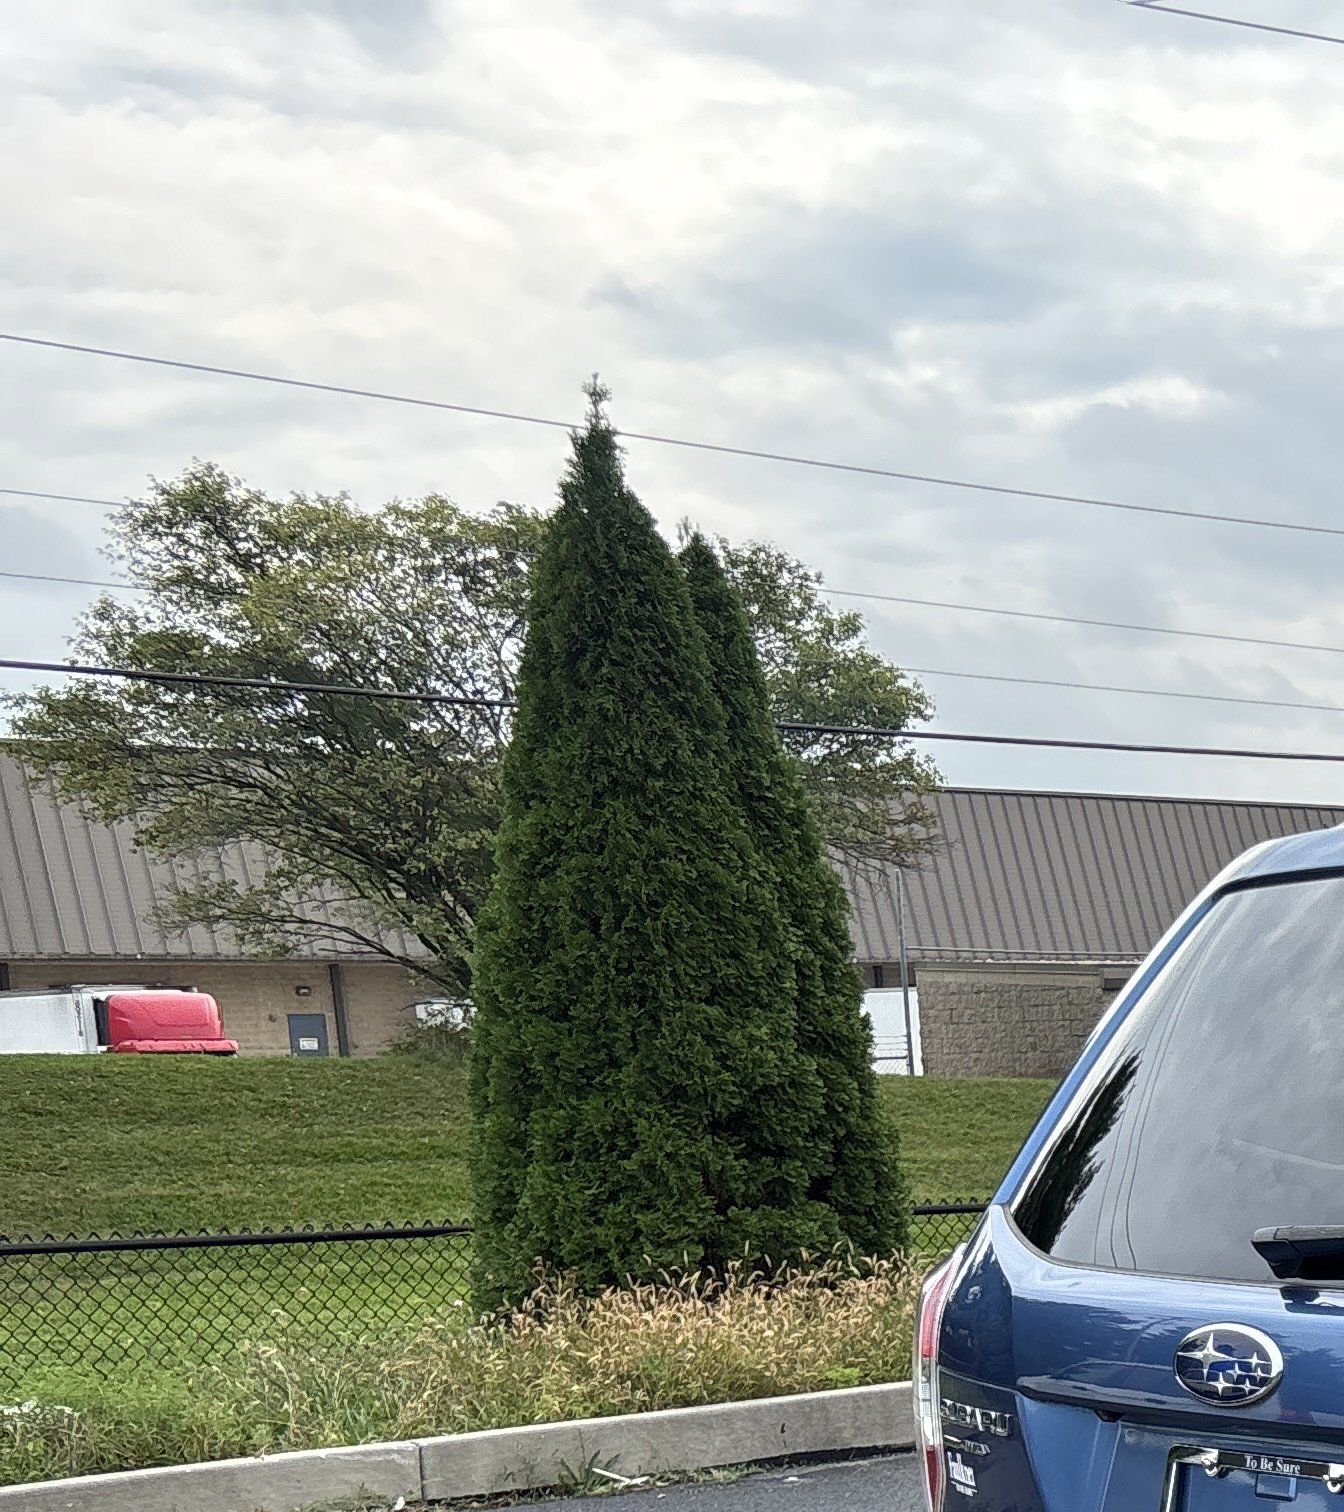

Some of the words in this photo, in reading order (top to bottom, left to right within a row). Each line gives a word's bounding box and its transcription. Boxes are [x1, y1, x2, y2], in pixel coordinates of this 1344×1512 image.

[1245, 1454, 1258, 1470] To
[1260, 1457, 1274, 1471] Be
[1276, 1459, 1301, 1475] Sure
